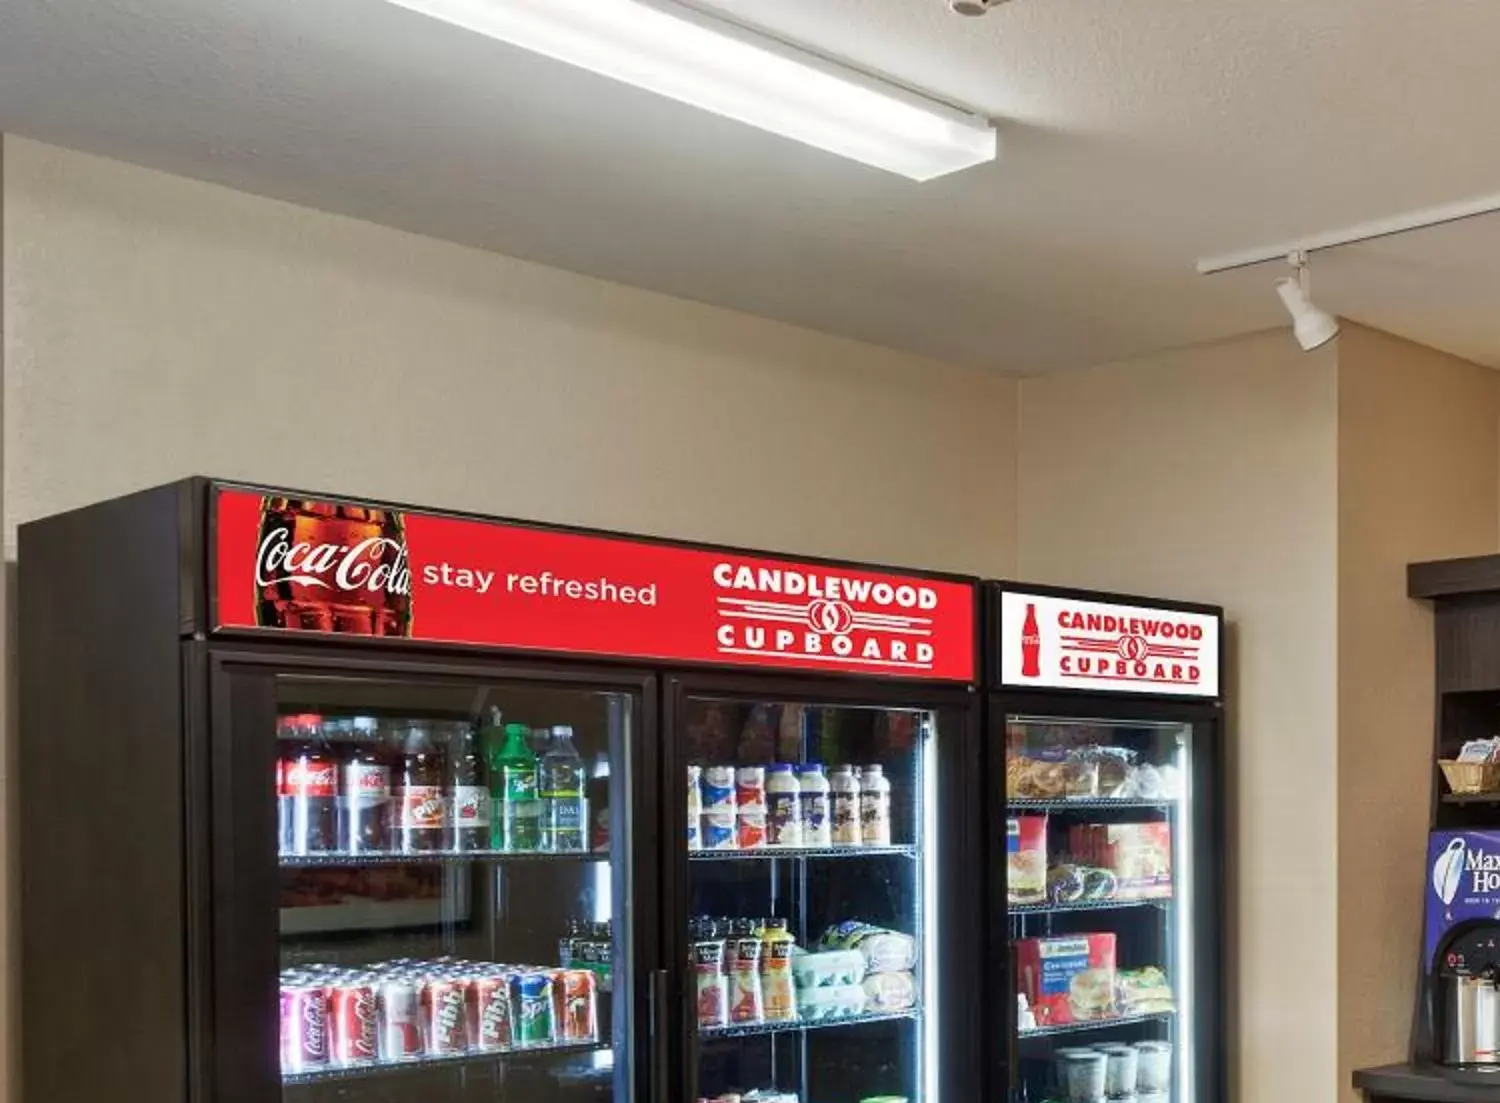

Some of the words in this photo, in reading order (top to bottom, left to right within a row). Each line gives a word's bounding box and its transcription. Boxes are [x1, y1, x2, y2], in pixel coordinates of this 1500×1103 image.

[256, 527, 411, 595] Coca-Cola
[422, 562, 494, 593] stay
[507, 572, 657, 606] refreshed
[714, 563, 937, 609] CANDLEWOOD
[717, 625, 934, 662] CUPBOARD
[1058, 611, 1203, 640] CANDLEWOOD
[1060, 656, 1200, 679] CUPBOARD
